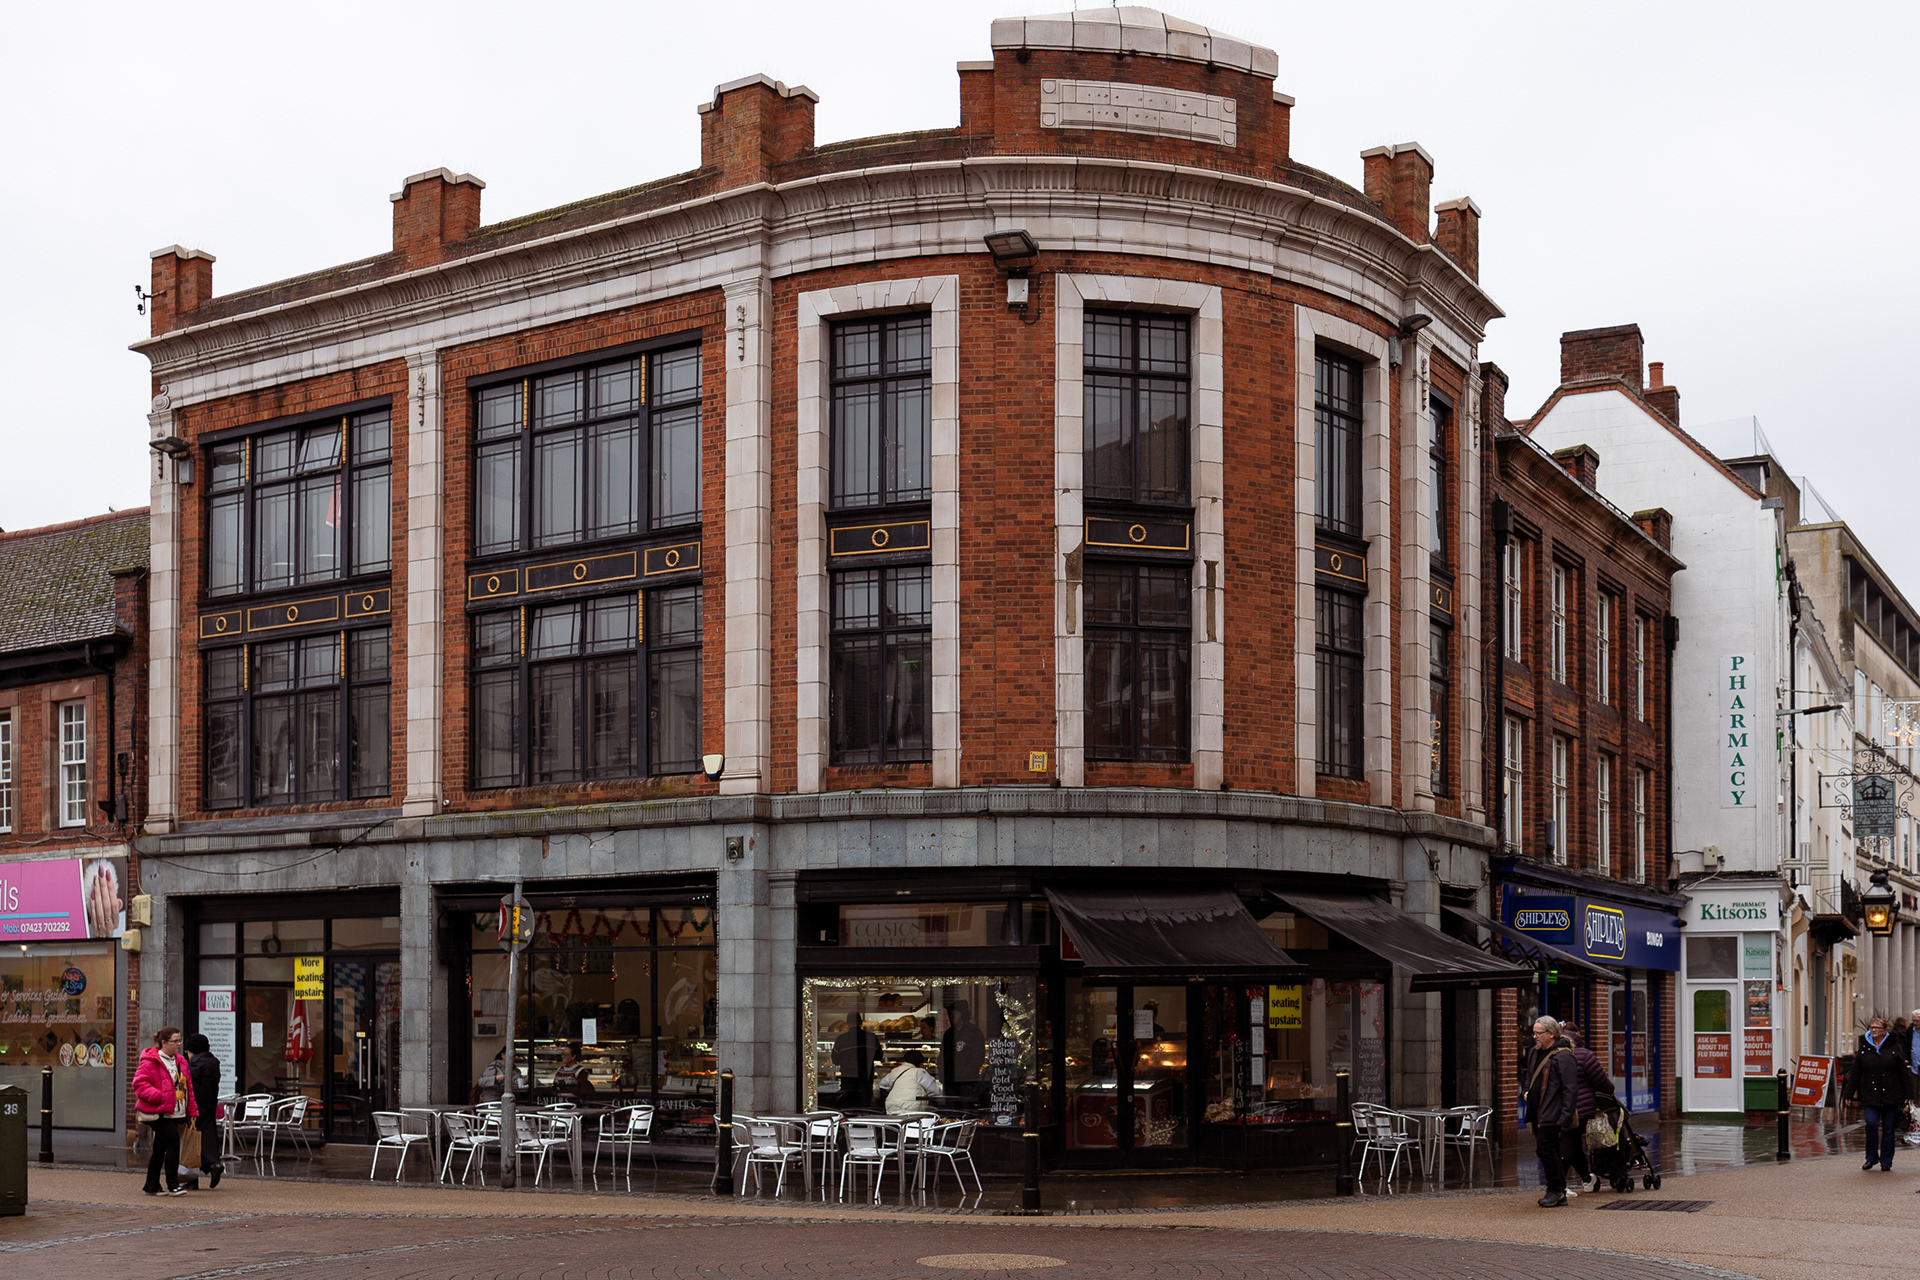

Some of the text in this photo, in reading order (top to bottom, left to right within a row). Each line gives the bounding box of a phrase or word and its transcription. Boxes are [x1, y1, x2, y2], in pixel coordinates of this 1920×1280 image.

[1728, 656, 1748, 805] PHARMACY
[1700, 904, 1767, 920] Kitsons
[1516, 912, 1568, 928] SHIPLEYS
[3, 922, 70, 934] Mob: 07423 702292
[1585, 912, 1625, 951] SHIPLEYS
[1646, 931, 1664, 948] BINGO
[1745, 947, 1770, 956] Kitsons
[301, 958, 320, 967] More
[296, 972, 324, 984] seating
[70, 980, 84, 990] Spa
[10, 988, 42, 1003] Services
[44, 988, 68, 1005] Guide
[1272, 997, 1300, 1010] seating
[30, 1010, 46, 1024] and
[1270, 1014, 1302, 1027] upstairs
[992, 1075, 1011, 1084] Cold
[993, 1083, 1014, 1092] Food
[4, 1104, 18, 1114] 38
[990, 1102, 1002, 1112] all
